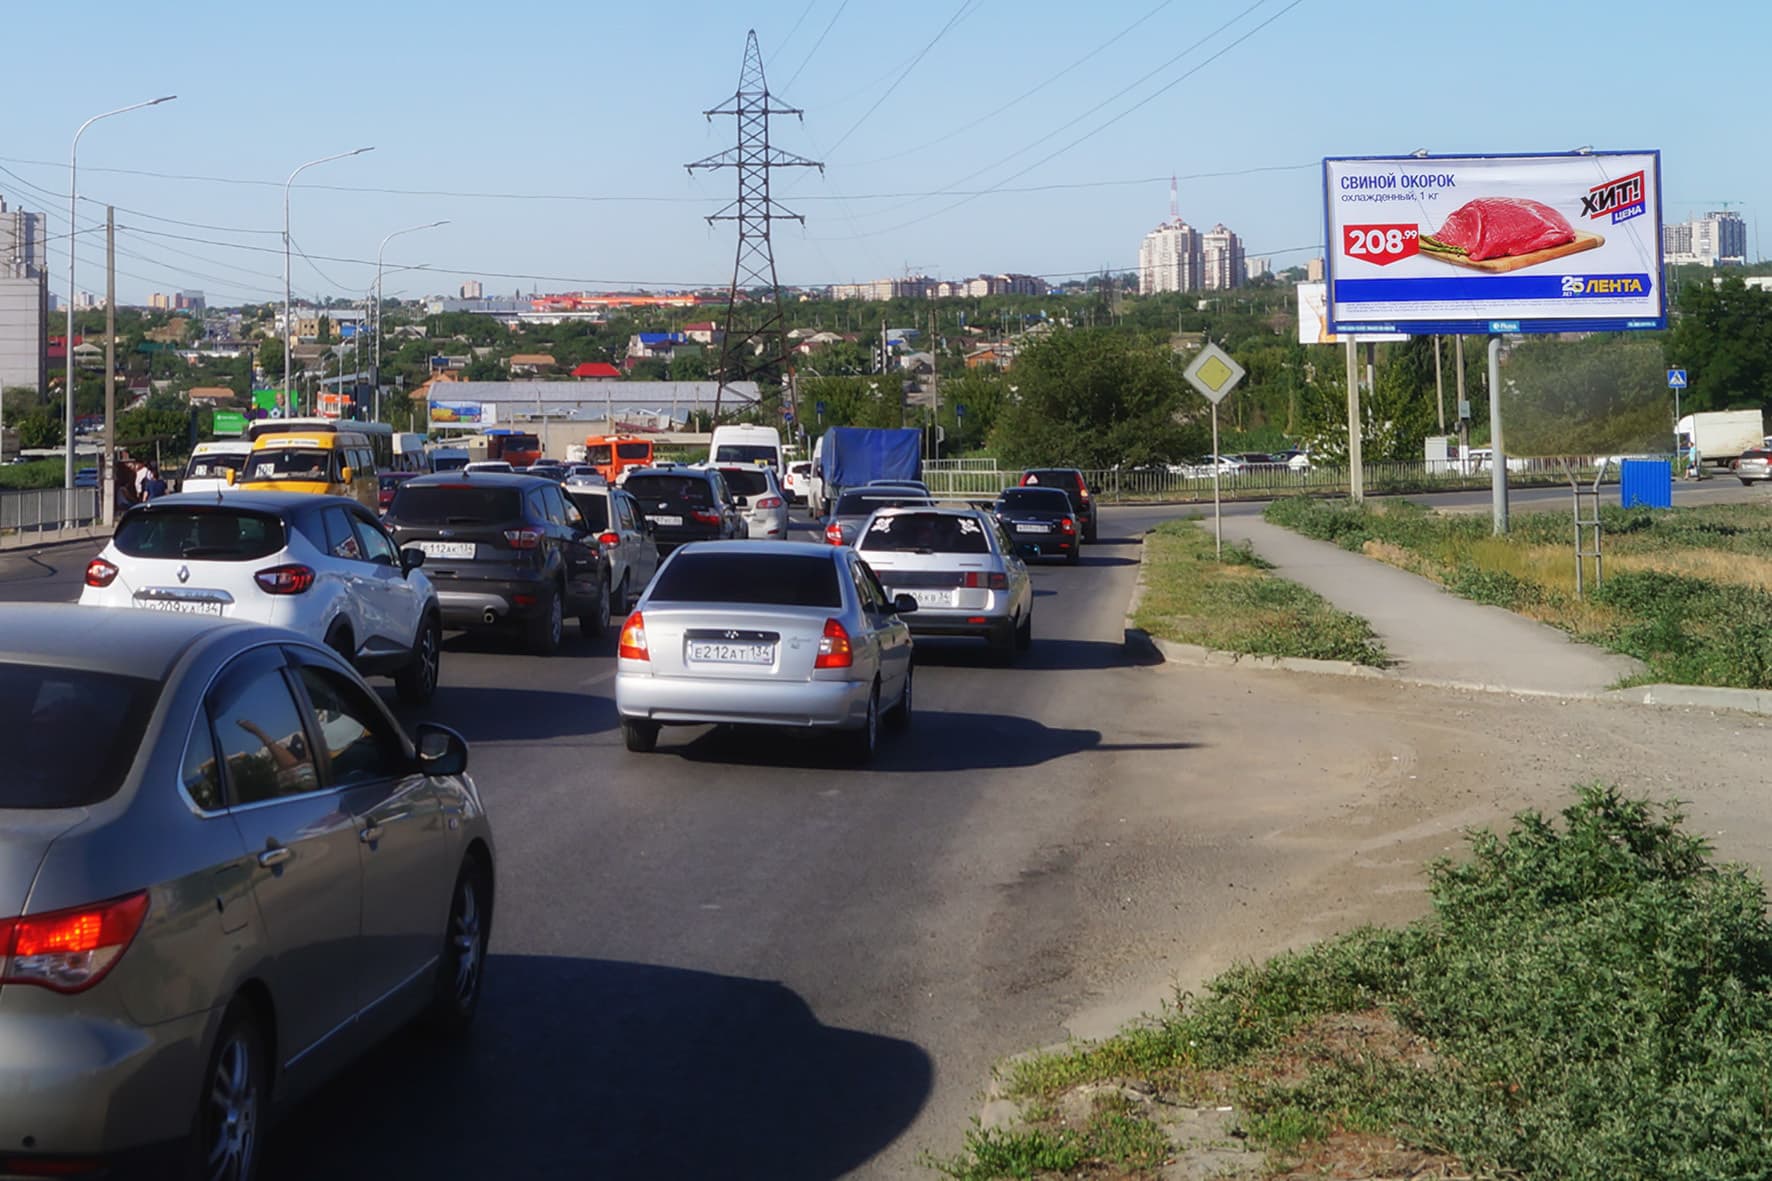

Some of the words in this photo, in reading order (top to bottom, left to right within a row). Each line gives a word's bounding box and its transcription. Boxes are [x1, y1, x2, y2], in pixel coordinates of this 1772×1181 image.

[1341, 172, 1396, 190] СВИНОЙ
[1400, 174, 1456, 188] ОКОРОК
[1341, 191, 1417, 202] охлажденный,
[1428, 192, 1439, 200] кг
[1580, 178, 1640, 218] ХИТ!
[1615, 205, 1642, 221] ЦЕНА
[1585, 278, 1643, 293] ЛЕНТА
[695, 646, 747, 659] Е212АТ
[751, 646, 770, 657] 134
